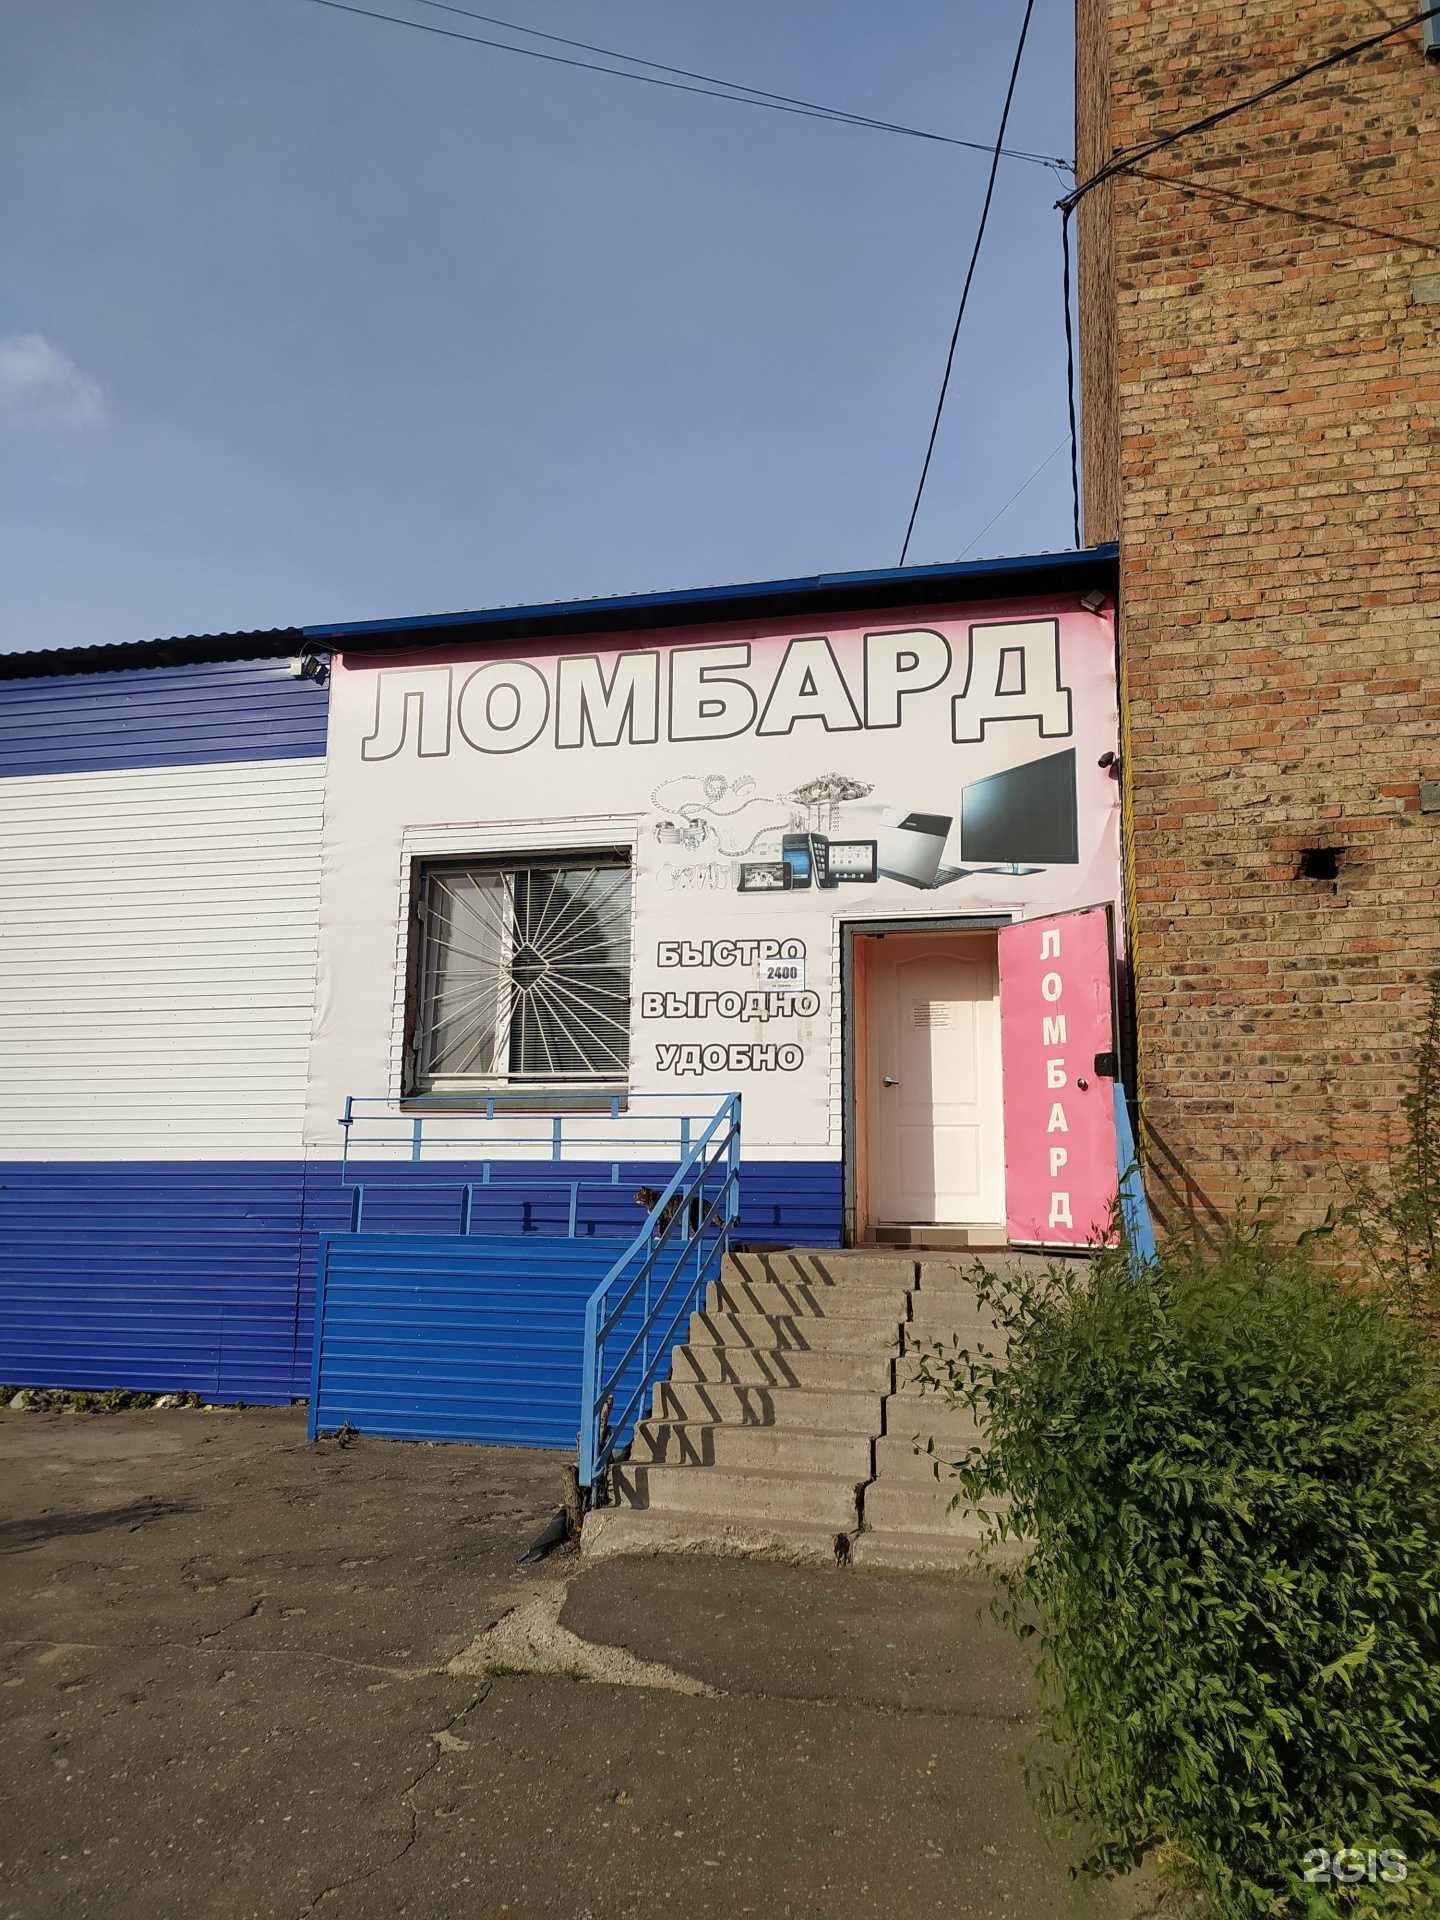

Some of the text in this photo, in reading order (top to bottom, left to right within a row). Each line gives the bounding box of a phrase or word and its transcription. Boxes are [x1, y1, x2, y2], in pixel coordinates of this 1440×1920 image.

[361, 618, 1073, 762] ЛОМБАРД
[657, 938, 806, 967] БЫСТРО
[641, 990, 820, 1022] ВЫГОДНО
[655, 1043, 804, 1076] УДОБНО
[1040, 929, 1073, 1229] ЛОМБАРД
